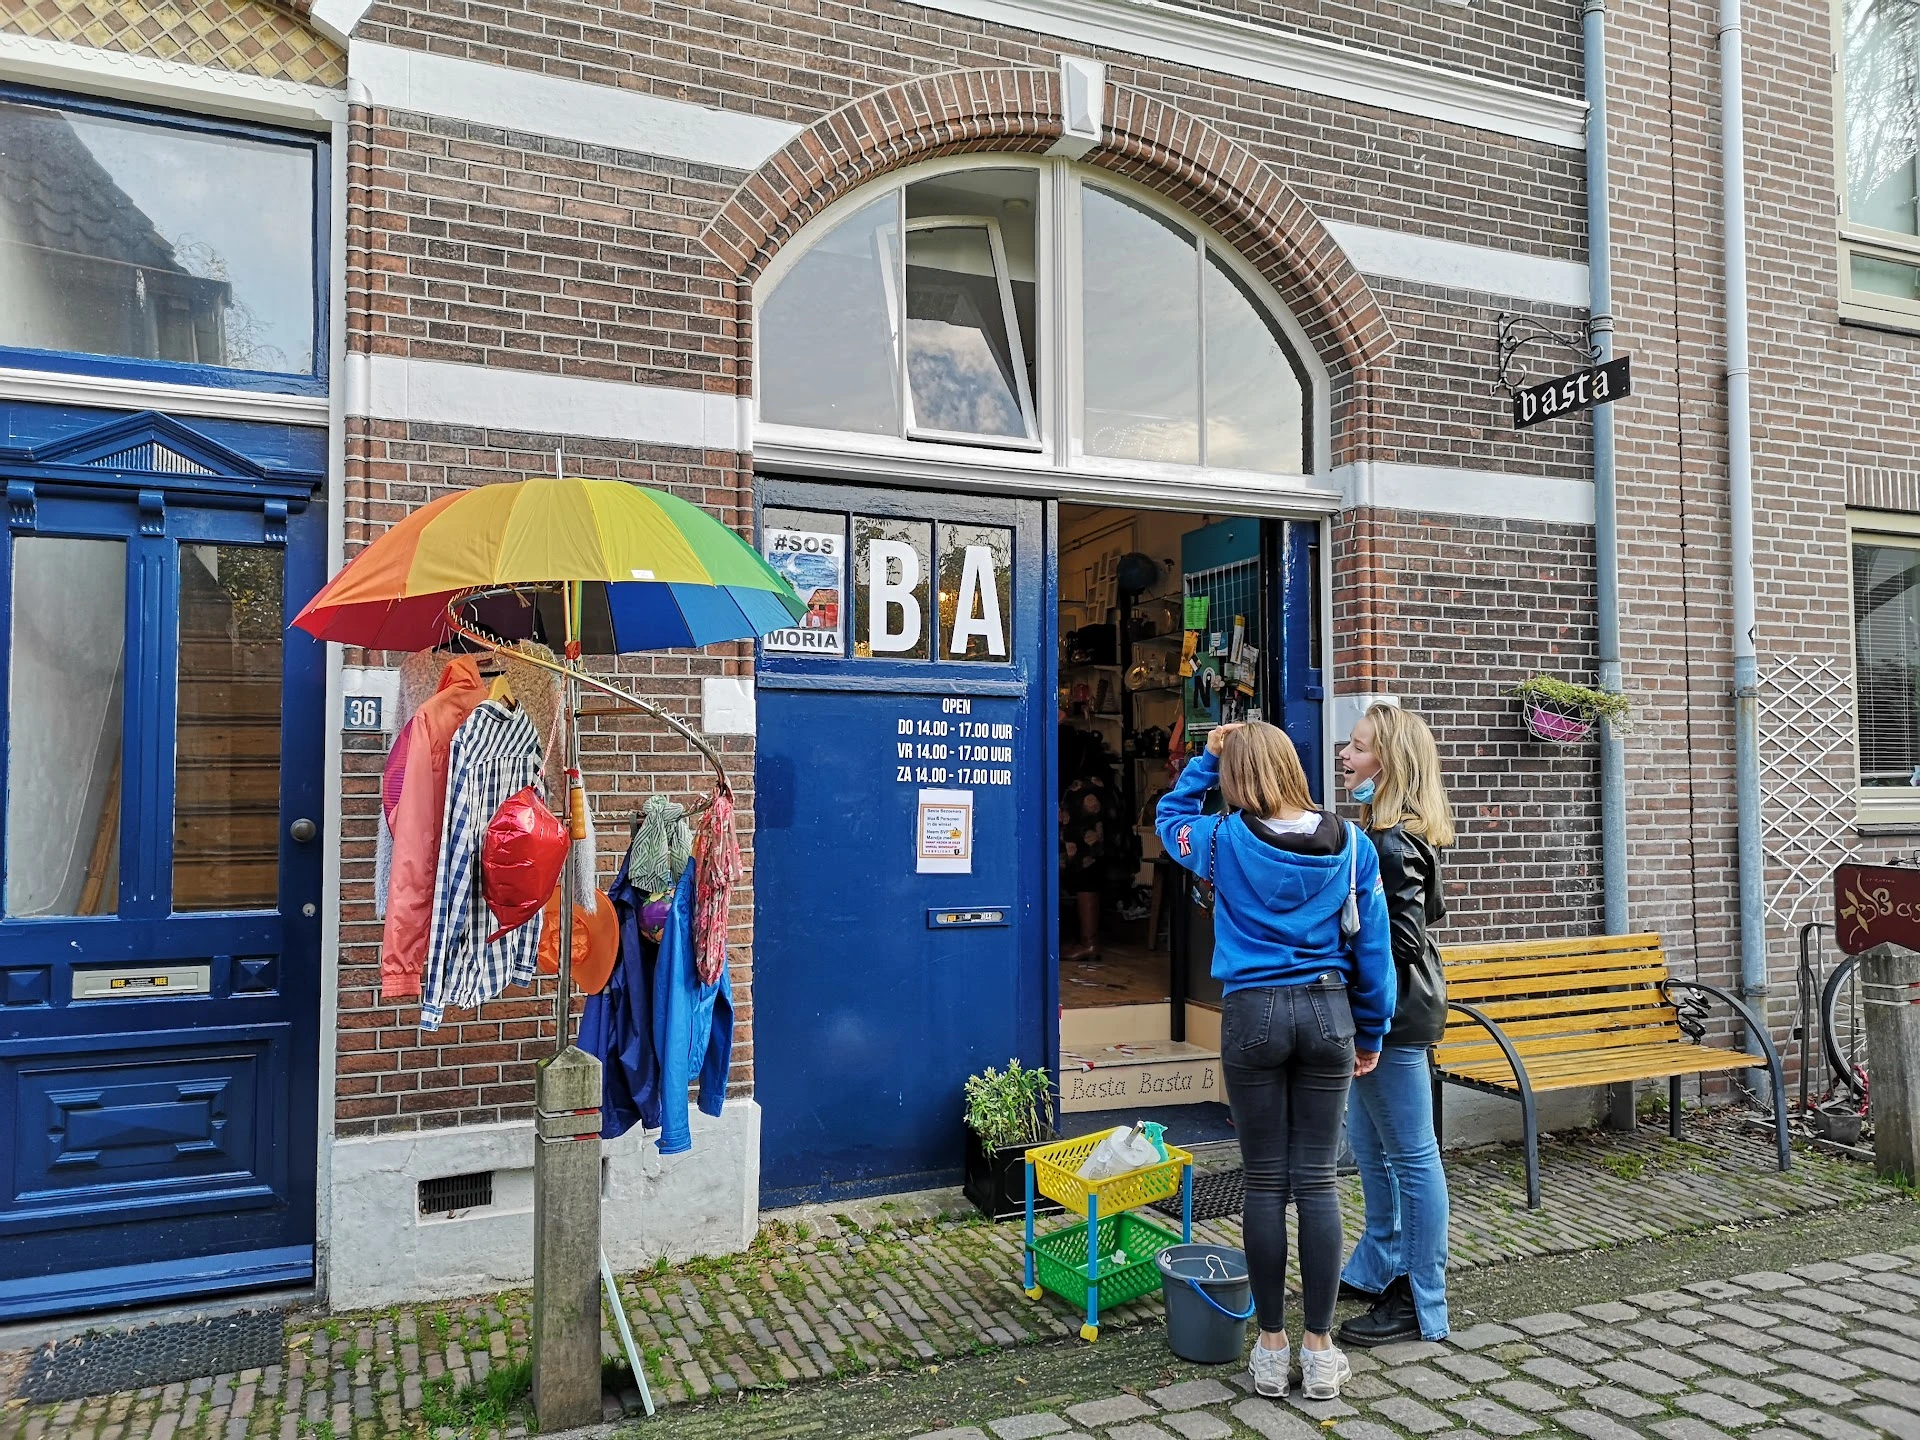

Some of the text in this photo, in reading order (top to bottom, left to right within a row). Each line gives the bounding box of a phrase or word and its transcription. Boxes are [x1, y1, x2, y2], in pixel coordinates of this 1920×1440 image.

[1521, 370, 1610, 422] basta
[773, 533, 835, 555] #SOS
[767, 630, 838, 649] MORIA
[350, 700, 376, 726] 36
[942, 698, 971, 714] OPEN
[897, 719, 913, 735] DO
[917, 720, 948, 736] 14.00
[959, 722, 989, 738] 17.00
[991, 723, 1013, 739] UUR
[897, 742, 913, 758] VR
[916, 743, 947, 760] 14.00
[958, 745, 988, 761] 17.00
[990, 746, 1012, 762] UUR
[896, 766, 912, 782] ZA
[915, 767, 946, 783] 14.00
[957, 768, 987, 784] 17.00
[989, 769, 1012, 785] UUR
[112, 980, 126, 988] NEE
[155, 978, 167, 986] NEE
[1071, 1067, 1214, 1100] Basta Basta B
